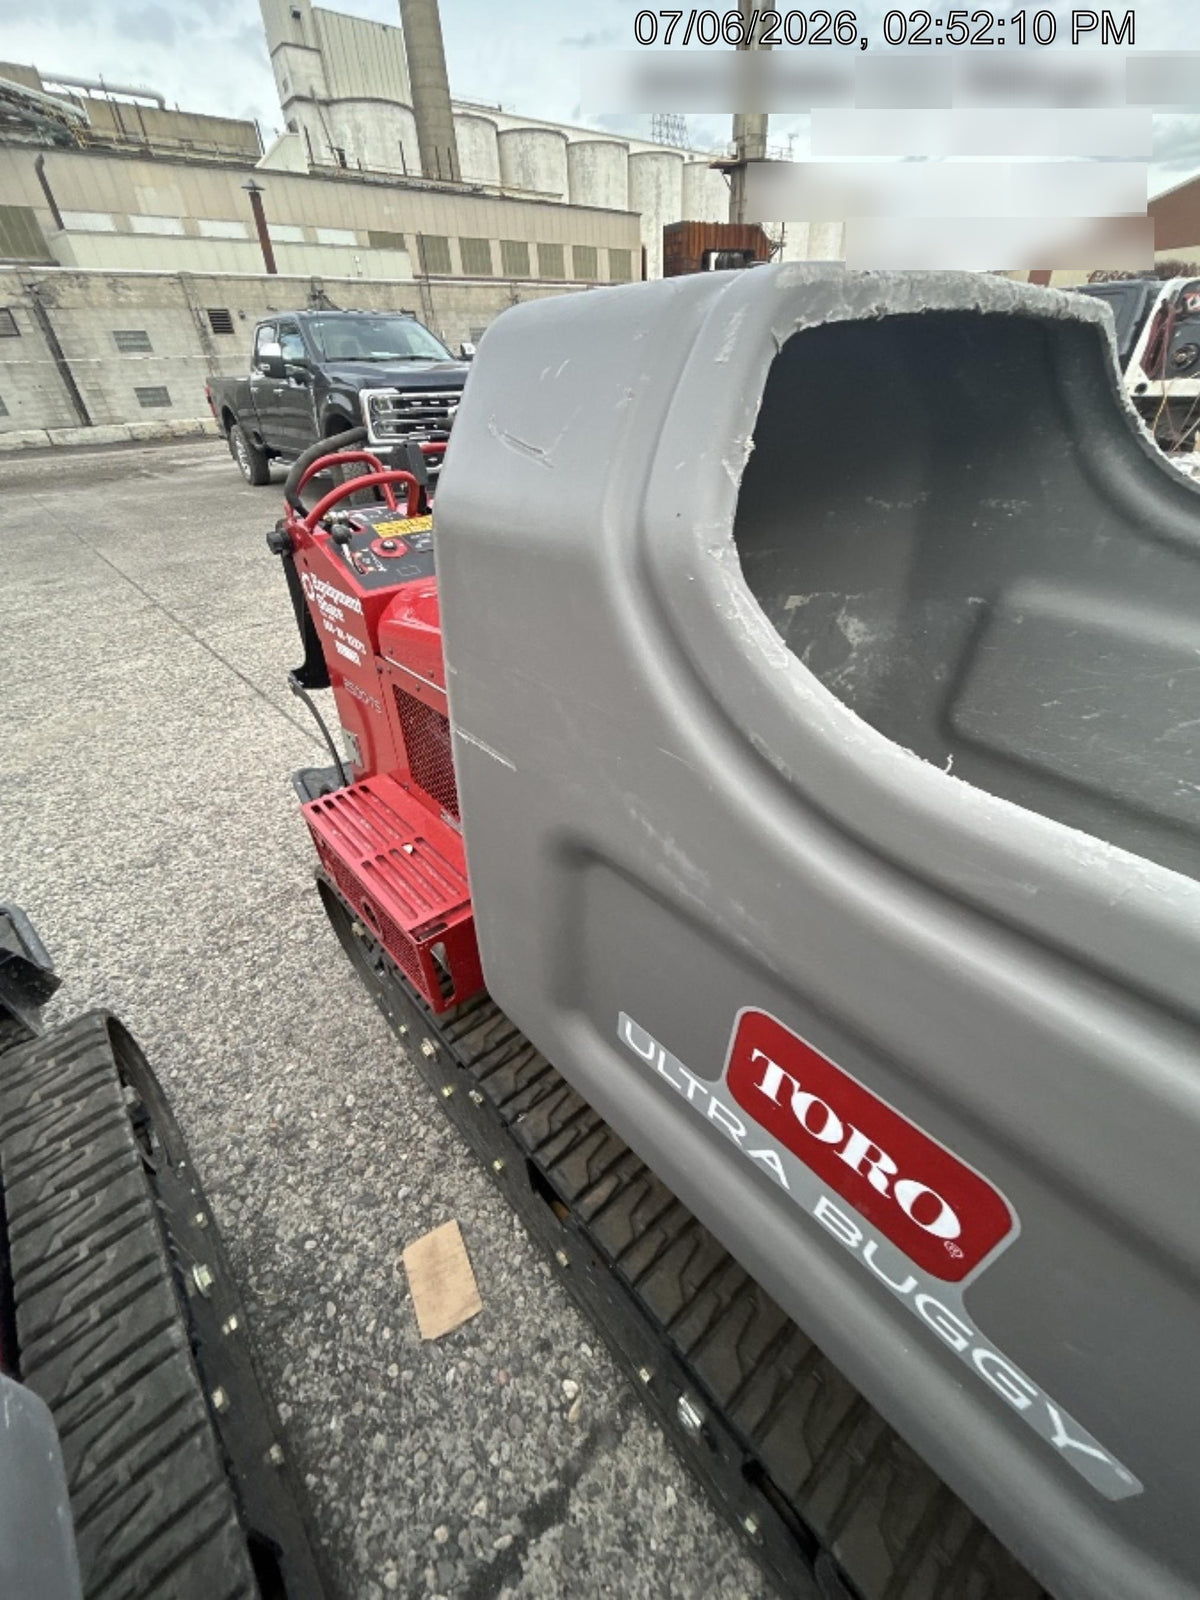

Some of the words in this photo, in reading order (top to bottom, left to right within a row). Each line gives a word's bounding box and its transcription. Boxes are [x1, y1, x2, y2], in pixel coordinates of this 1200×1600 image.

[623, 1017, 791, 1191] ULTRA
[812, 1195, 1113, 1465] BUGGY
[750, 1047, 962, 1240] TORO
